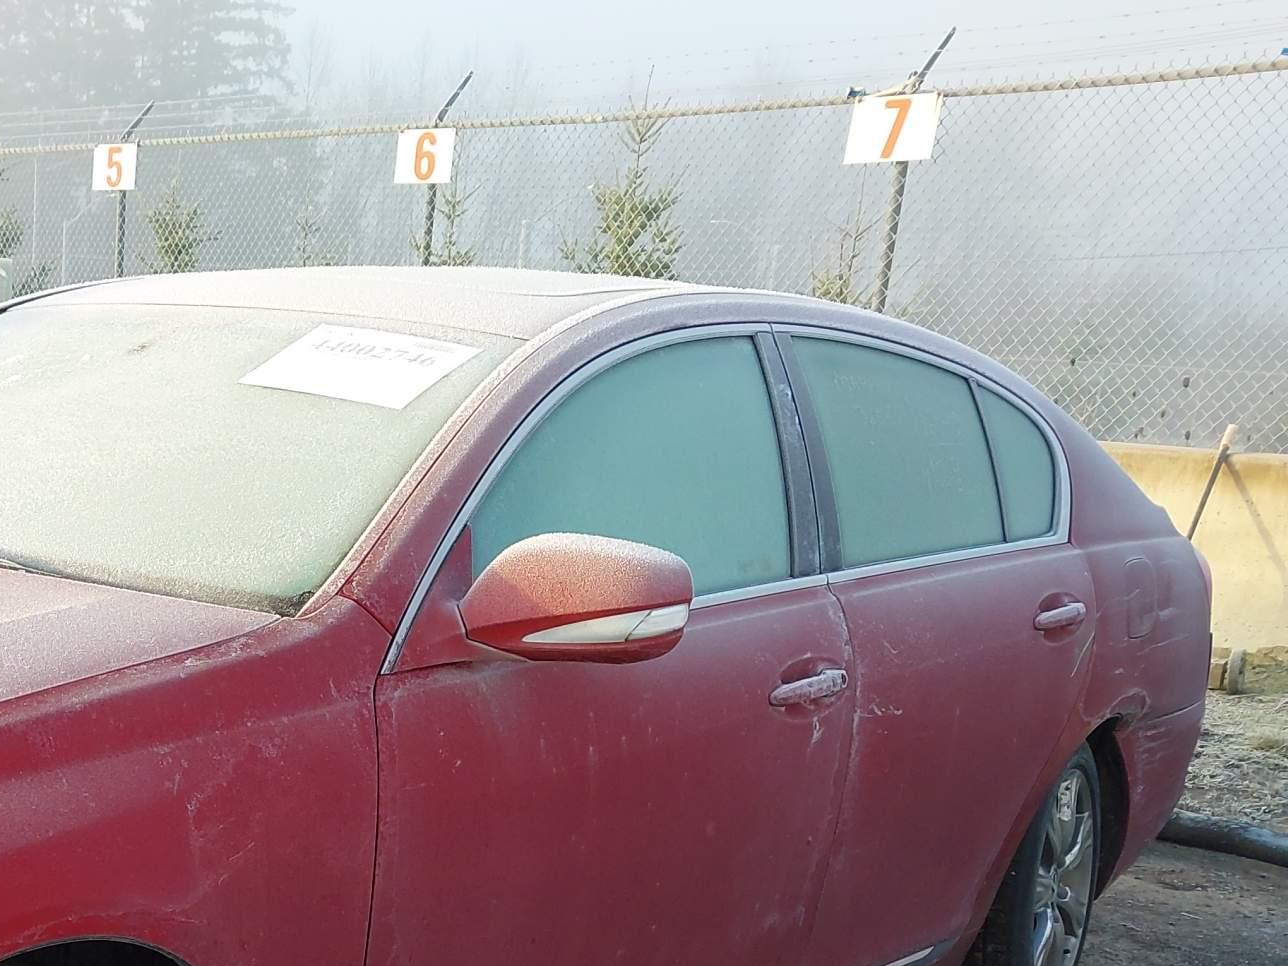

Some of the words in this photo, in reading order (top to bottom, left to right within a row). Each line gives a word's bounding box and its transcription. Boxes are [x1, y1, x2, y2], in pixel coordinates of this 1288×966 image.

[880, 98, 912, 159] 7
[106, 146, 122, 188] 5
[414, 131, 437, 181] 6
